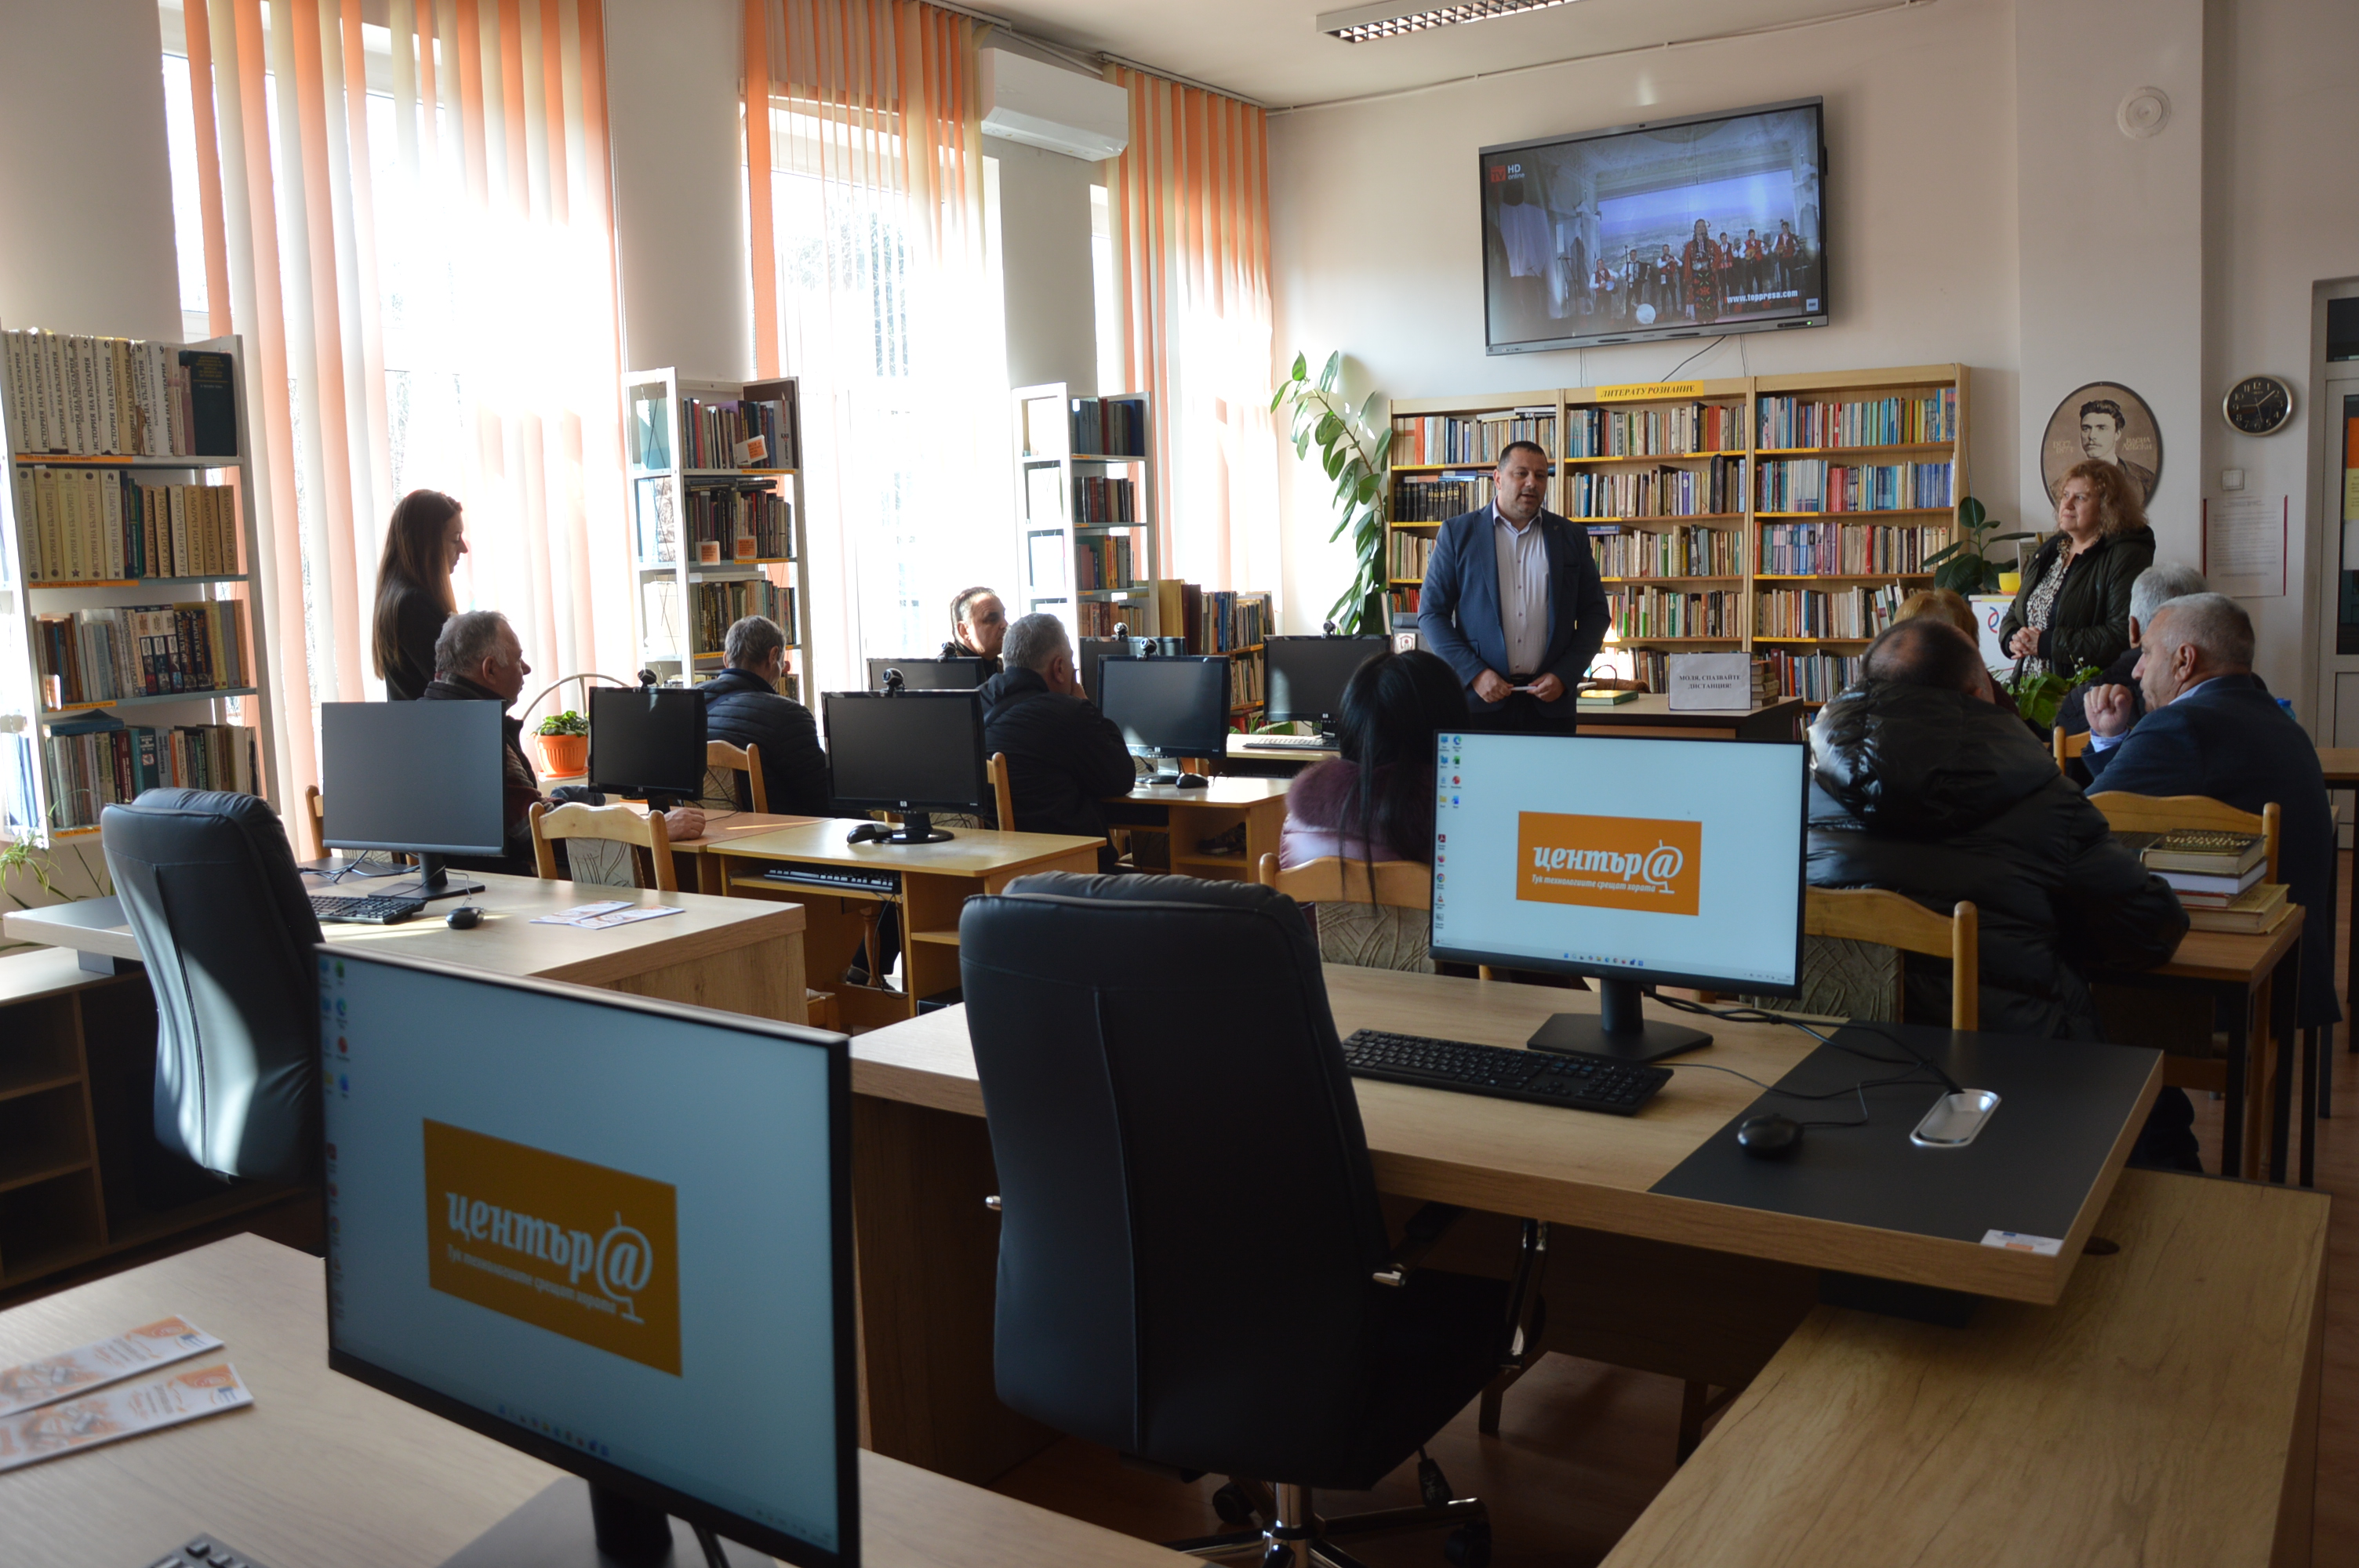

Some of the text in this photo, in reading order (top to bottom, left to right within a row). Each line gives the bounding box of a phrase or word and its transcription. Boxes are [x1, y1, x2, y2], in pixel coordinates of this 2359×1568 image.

[1507, 163, 1521, 174] HD
[1727, 290, 1798, 304] www.toppresa.com
[53, 351, 61, 392] БЪЛГАРИЯ
[69, 358, 78, 397] БЪЛГАРИЯ
[85, 358, 93, 397] БЪЛГАРИЯ
[105, 357, 114, 397] БЪЛГАРИЯ
[139, 360, 147, 400] БЪЛГАРИЯ
[15, 335, 30, 448] ИСТОРИЯ НА БЪЛГАРИЯ 1
[32, 336, 47, 448] ИСТОРИЯ НА БЪЛГАРИЯ 2
[57, 395, 63, 405] НА
[74, 400, 79, 411] НА
[89, 400, 95, 410] НА
[108, 399, 114, 409] НА
[129, 401, 133, 412] НА
[144, 403, 150, 413] НА
[165, 404, 169, 414] НА
[57, 408, 67, 447] ИСТОРИЯ
[75, 415, 83, 451] ИСТОРИЯ
[89, 413, 99, 450] ИСТОРИЯ
[129, 414, 137, 451] ИСТОРИЯ
[146, 416, 154, 452] ИСТОРИЯ
[24, 490, 38, 571] ИСТОРИЯ НА БЪЛГАРИТЕ
[50, 528, 56, 537] НА
[91, 530, 97, 539] НА
[112, 528, 118, 537] НА
[50, 539, 59, 568] ИСТОРИЯ
[71, 539, 79, 568] ИСТОРИЯ
[92, 541, 100, 570] ИСТОРИЯ
[112, 539, 121, 568] ИСТОРИЯ
[1533, 840, 1684, 890] център@
[1532, 873, 1656, 893] Тук технологиите срещат хората
